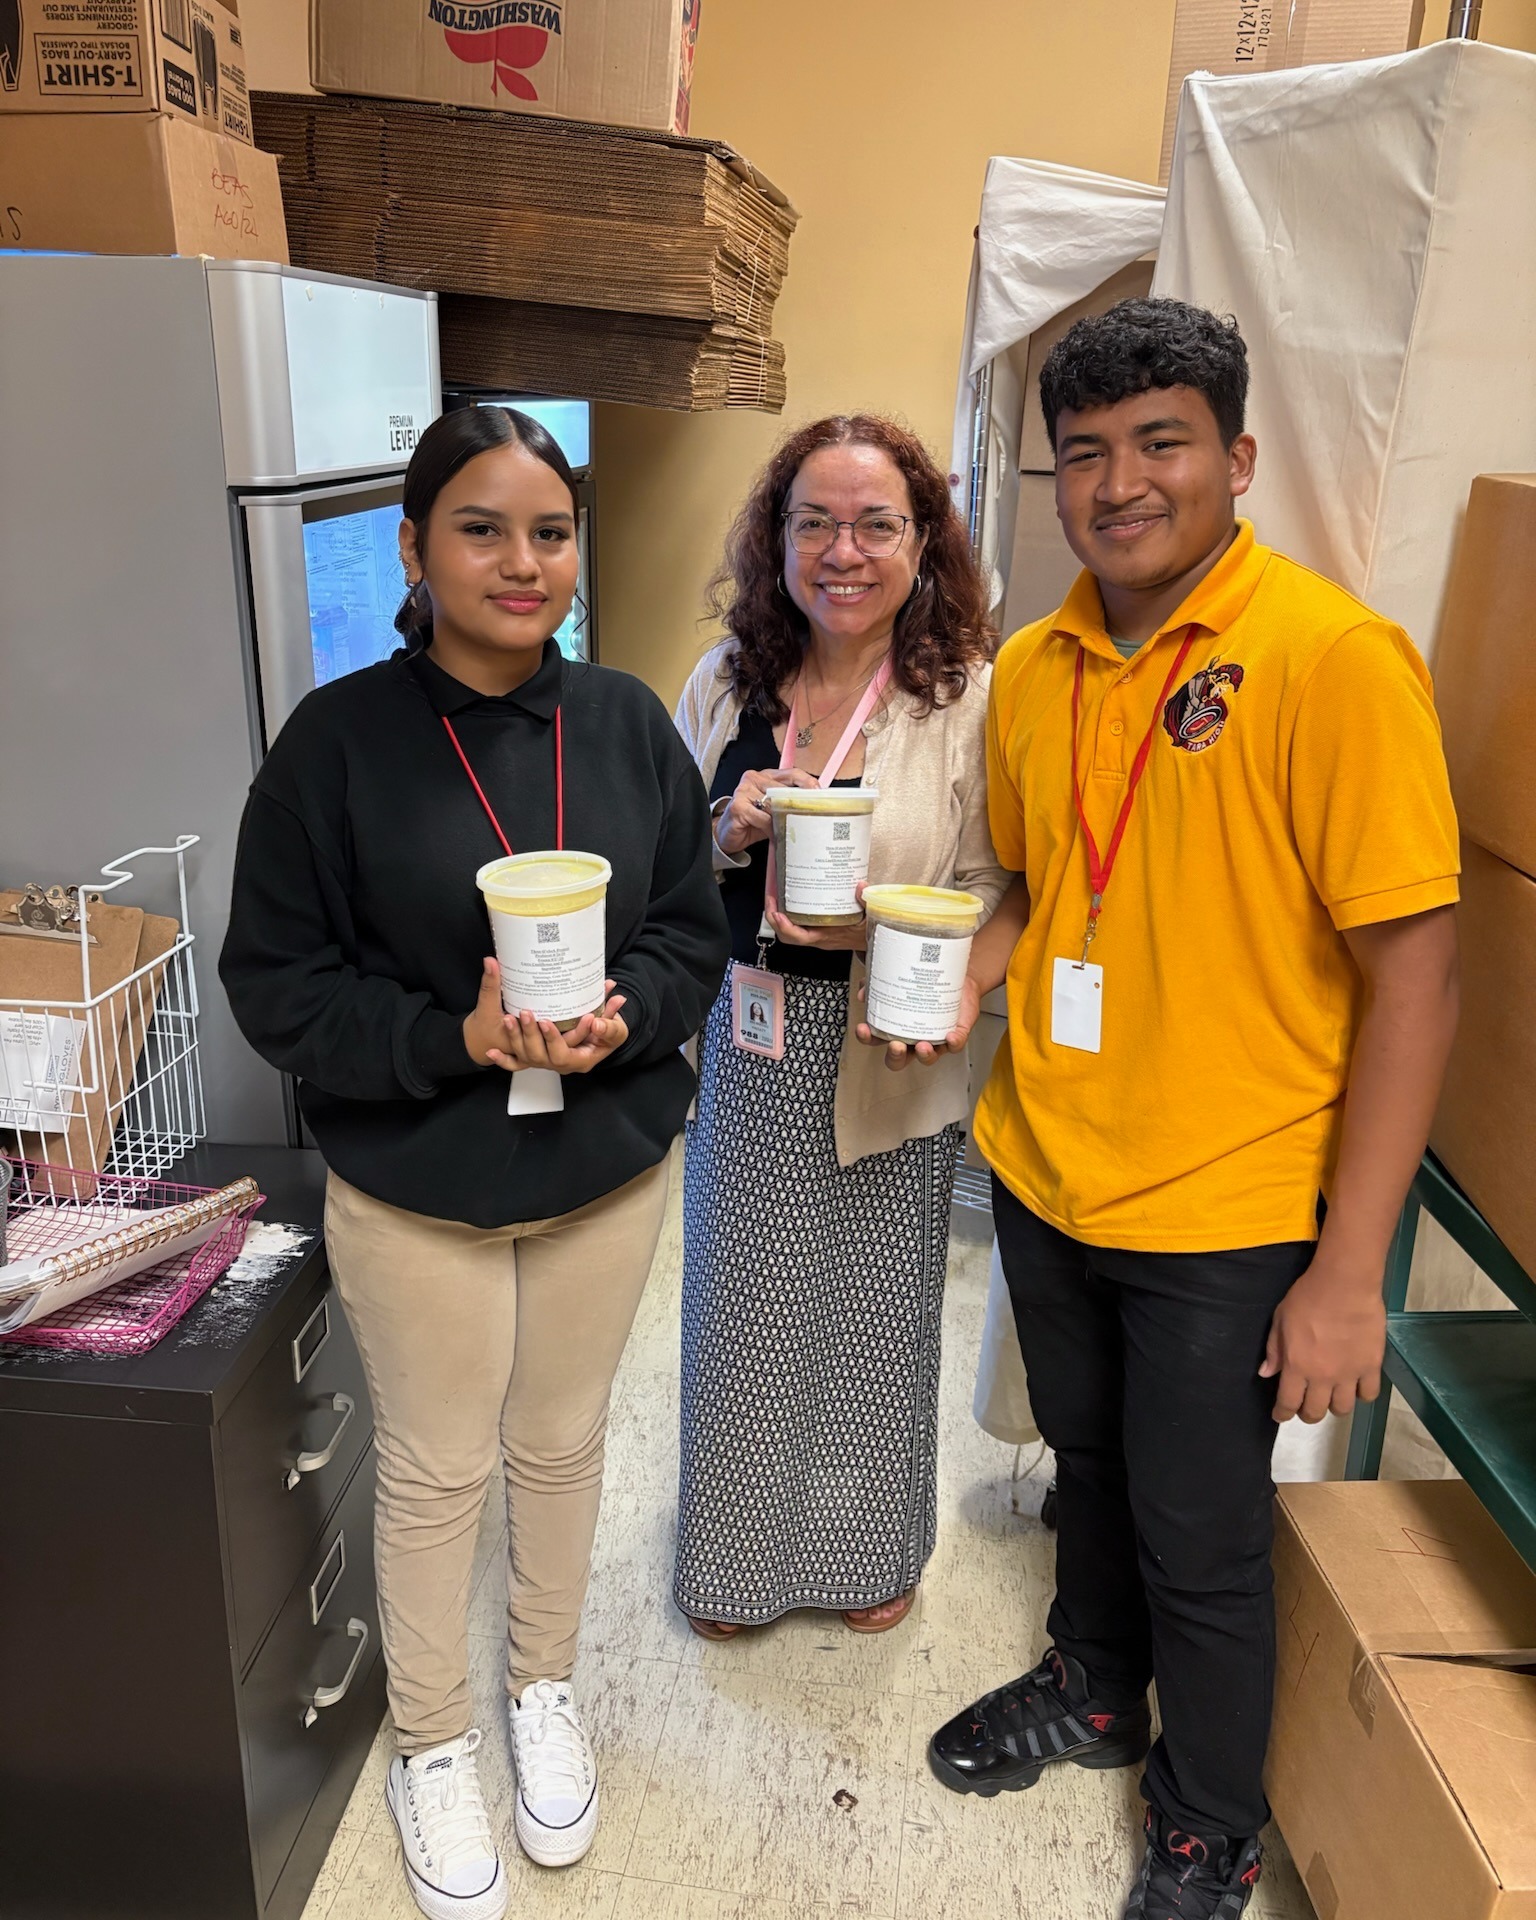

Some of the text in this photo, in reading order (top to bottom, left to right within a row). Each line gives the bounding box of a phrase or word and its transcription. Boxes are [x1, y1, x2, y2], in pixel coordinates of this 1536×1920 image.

[42, 4, 133, 12] RESTAURANT TAKE OUT
[46, 12, 133, 22] CONVENIENCE STORES
[428, 0, 561, 35] WASHINGTON
[96, 22, 134, 30] GROCERY
[1257, 8, 1272, 48] 170421
[41, 40, 130, 49] BOLSAS TIPO CAMISETA
[41, 50, 132, 60] CARRY-OUT BAGS
[44, 64, 137, 87] T-SHIRT
[224, 111, 250, 139] T-SHIRT
[389, 415, 414, 428] PREMIUM
[1186, 741, 1207, 752] TARA
